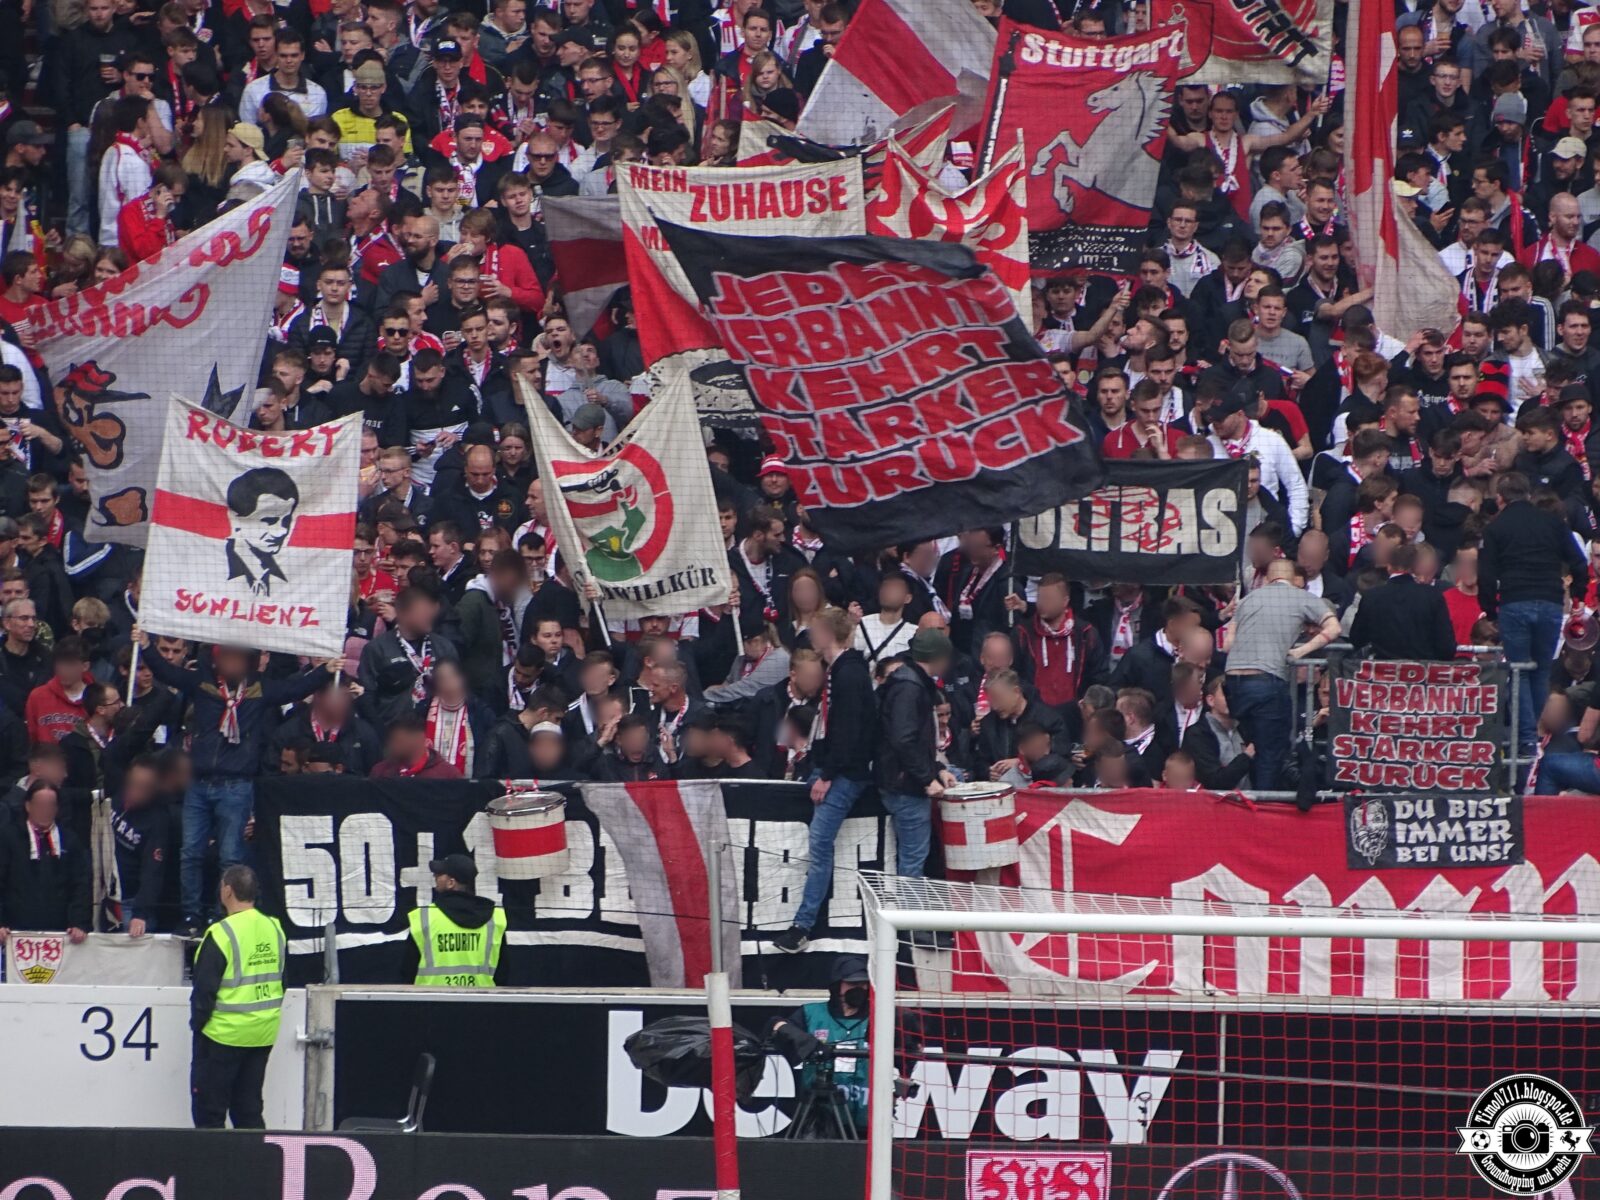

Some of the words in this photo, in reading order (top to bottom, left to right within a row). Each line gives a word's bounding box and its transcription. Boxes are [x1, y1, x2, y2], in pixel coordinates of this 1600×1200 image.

[1020, 29, 1185, 73] Stuttgart
[629, 166, 688, 194] MEIN
[689, 175, 848, 223] ZUHAUSE
[745, 327, 1011, 415] KEHRT
[186, 408, 343, 457] ROBERT
[1018, 485, 1239, 557] ULTRAS
[174, 588, 320, 628] SCHLIENZ
[1354, 660, 1481, 686] JEDER
[1335, 678, 1499, 714] VERBANNTE
[1351, 711, 1484, 738] KEHRT
[1334, 760, 1491, 791] ZURÜCK
[1394, 799, 1436, 820] DU
[1448, 797, 1512, 819] BIST
[1395, 820, 1514, 844] IMMER
[1396, 845, 1440, 863] BEI
[1450, 842, 1516, 863] UNS!
[437, 932, 481, 952] SECURITY
[79, 1005, 159, 1062] 34
